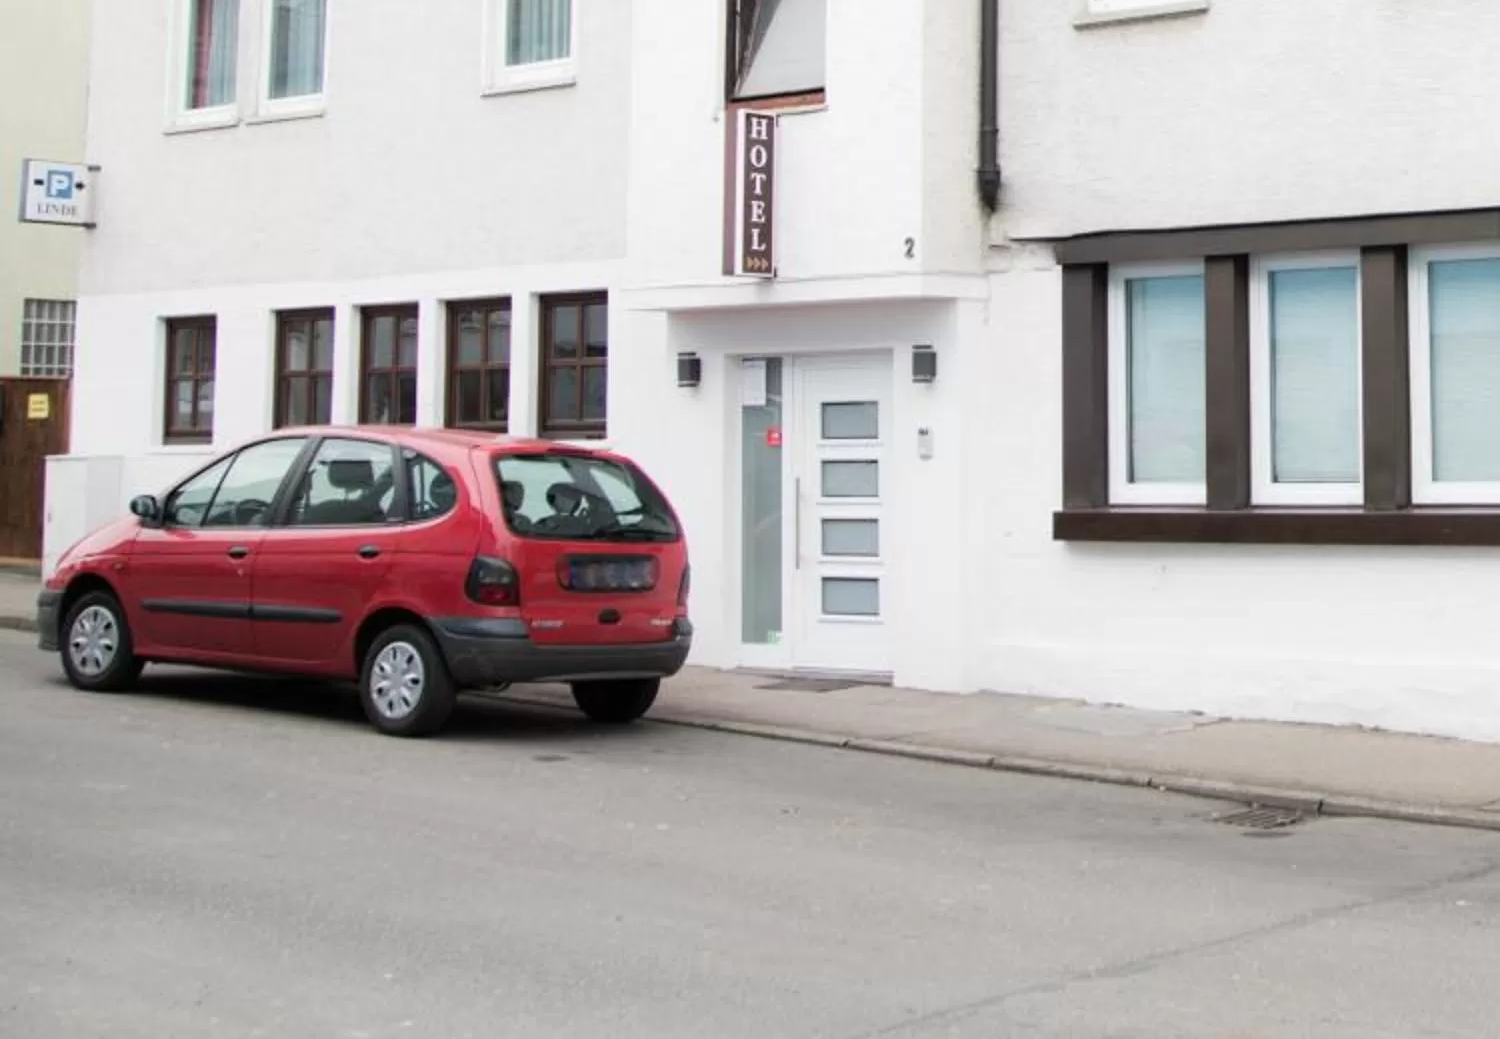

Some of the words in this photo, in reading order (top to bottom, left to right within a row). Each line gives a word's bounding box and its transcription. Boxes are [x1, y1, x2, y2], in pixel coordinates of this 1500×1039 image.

[50, 173, 69, 197] P
[749, 117, 769, 252] HOTEL
[904, 236, 916, 260] 2
